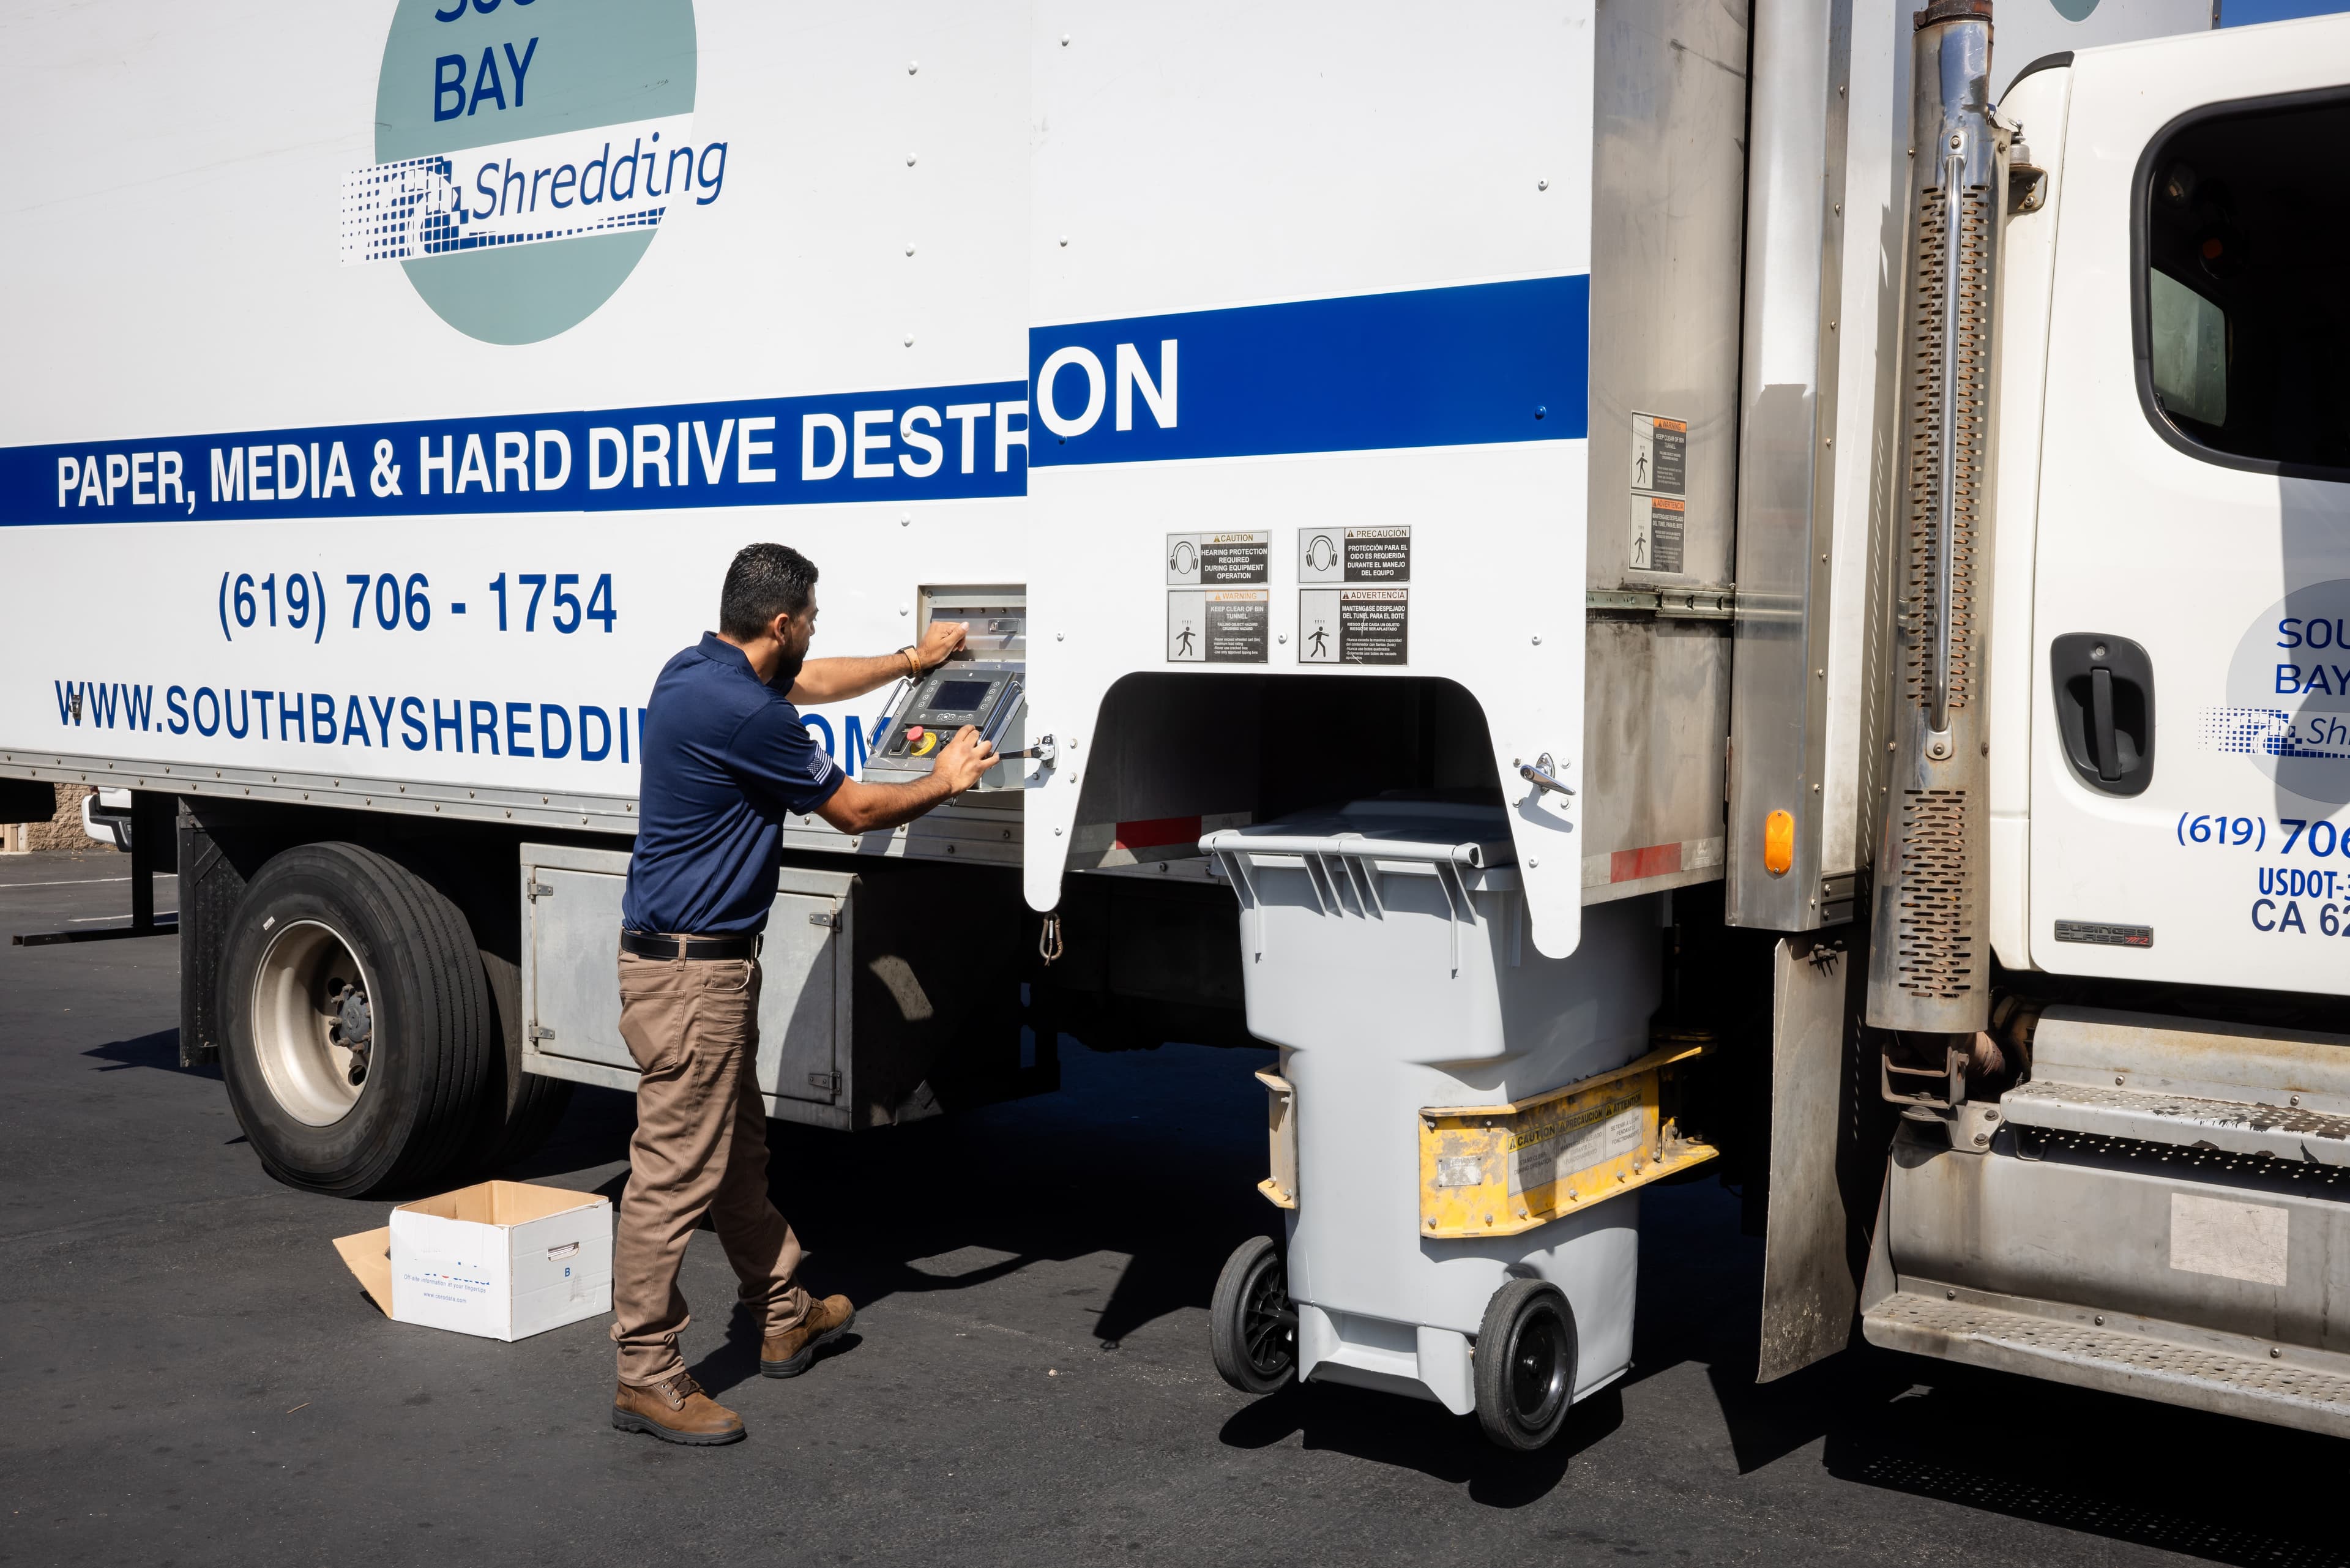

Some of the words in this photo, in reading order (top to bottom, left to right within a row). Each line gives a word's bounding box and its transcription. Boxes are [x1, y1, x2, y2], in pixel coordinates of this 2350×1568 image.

[434, 37, 539, 122] BAY
[472, 132, 728, 220] Shredding
[1037, 339, 1177, 437] ON
[1663, 420, 1681, 431] WARNING
[58, 451, 195, 515] PAPER,
[211, 441, 355, 504] MEDIA
[370, 439, 403, 497] &
[420, 430, 572, 495] HARD
[589, 417, 775, 490] DRIVE
[1657, 499, 1684, 509] ADVERTENCIA
[1356, 528, 1406, 537] PRECAUCIÓN
[218, 570, 326, 644] (619)
[346, 572, 430, 631] 706
[490, 572, 617, 634] 1754
[2275, 664, 2350, 695] BAY
[2177, 812, 2266, 852] (619)
[2251, 898, 2307, 934] CA
[2056, 924, 2150, 936] BUSINESS
[2056, 931, 2124, 943] CLASS
[1613, 1093, 1641, 1113] ATTENTION
[1565, 1108, 1602, 1130] PRECAUCION
[1520, 1157, 1532, 1165] STAND
[564, 1267, 570, 1277] B
[421, 1277, 446, 1286] information
[464, 1284, 486, 1293] fingertips
[423, 1292, 466, 1303] www.corodata.com
